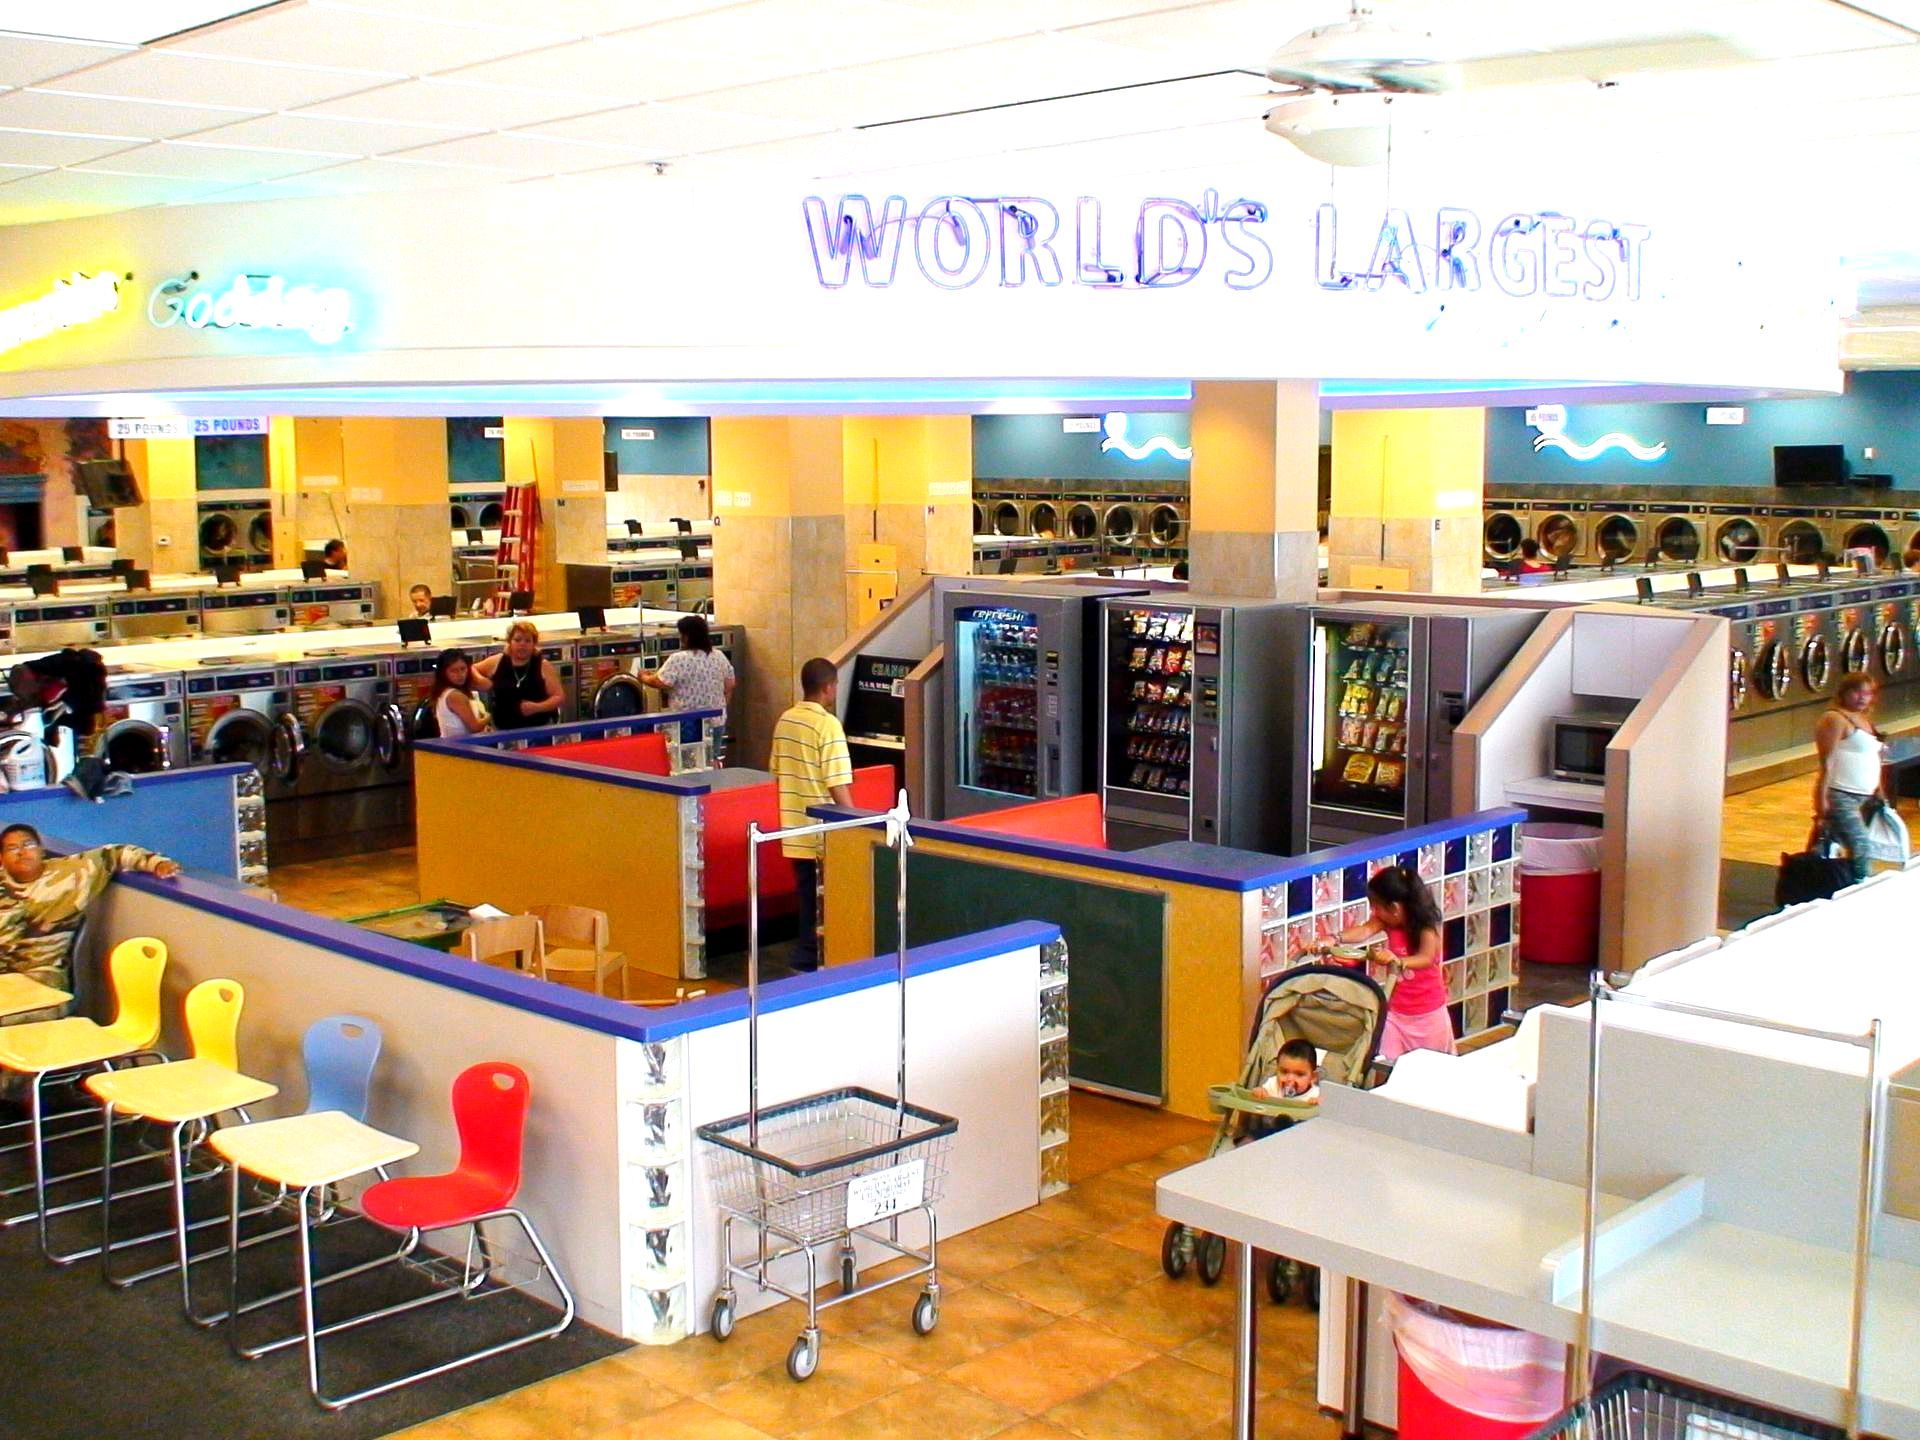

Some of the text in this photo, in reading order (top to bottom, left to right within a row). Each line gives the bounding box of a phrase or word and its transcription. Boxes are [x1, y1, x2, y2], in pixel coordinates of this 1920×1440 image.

[803, 189, 1654, 302] WORLD'S LARGEST
[117, 424, 130, 434] 25
[194, 418, 260, 432] 25 POUNDS
